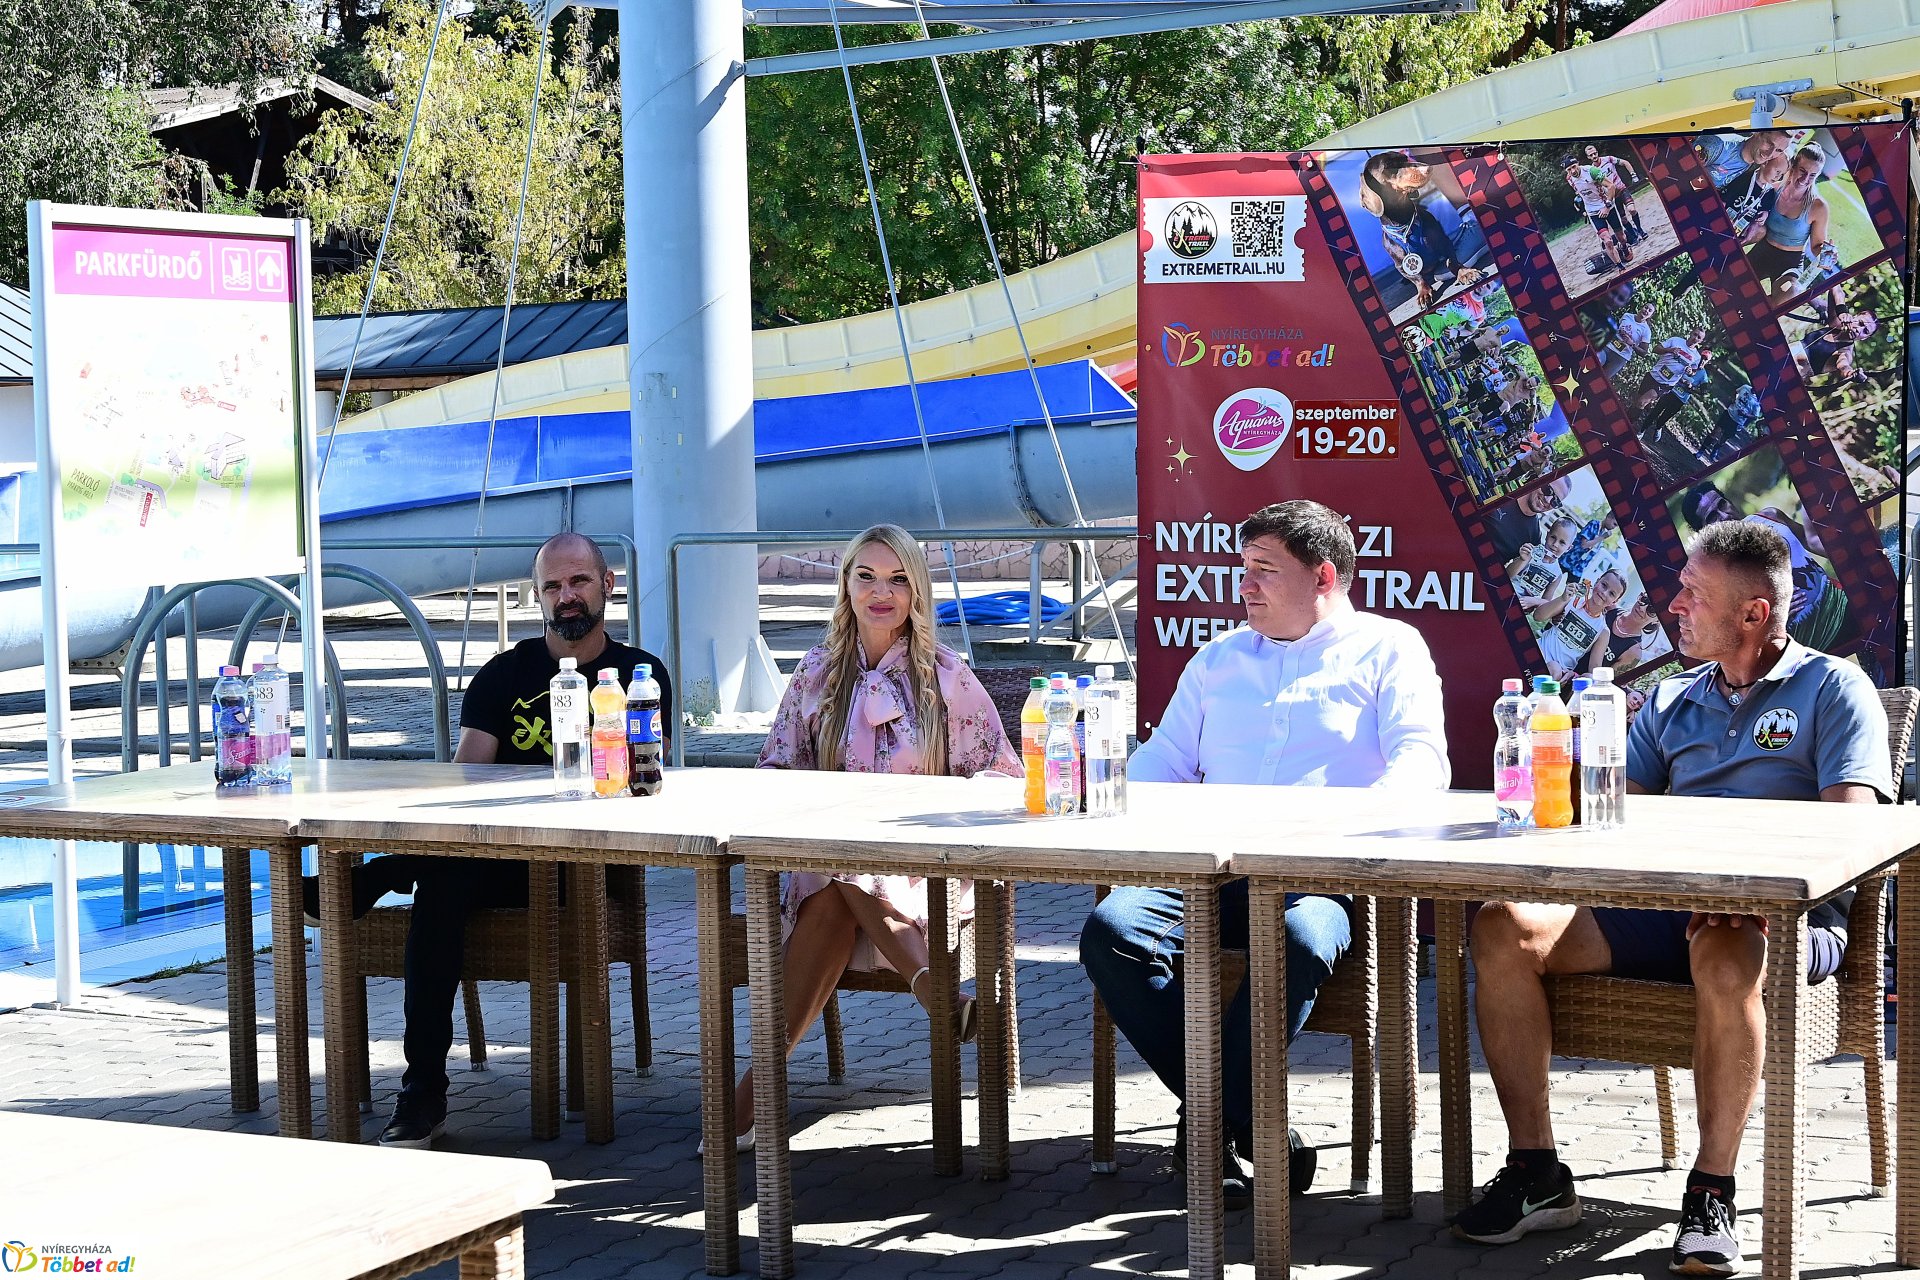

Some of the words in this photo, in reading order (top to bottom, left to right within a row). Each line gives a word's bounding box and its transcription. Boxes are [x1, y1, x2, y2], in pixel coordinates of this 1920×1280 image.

[75, 248, 202, 280] PARKFÜRDŐ
[1162, 262, 1285, 276] EXTREMETRAIL.HU
[1211, 326, 1304, 340] NYÍREGYHÁZA
[1211, 344, 1292, 367] Többet
[1295, 344, 1335, 367] ad!
[1295, 405, 1397, 423] szeptember
[1219, 411, 1284, 449] Aquarius
[1296, 426, 1396, 454] 19-20.
[1359, 569, 1485, 611] TRAIL
